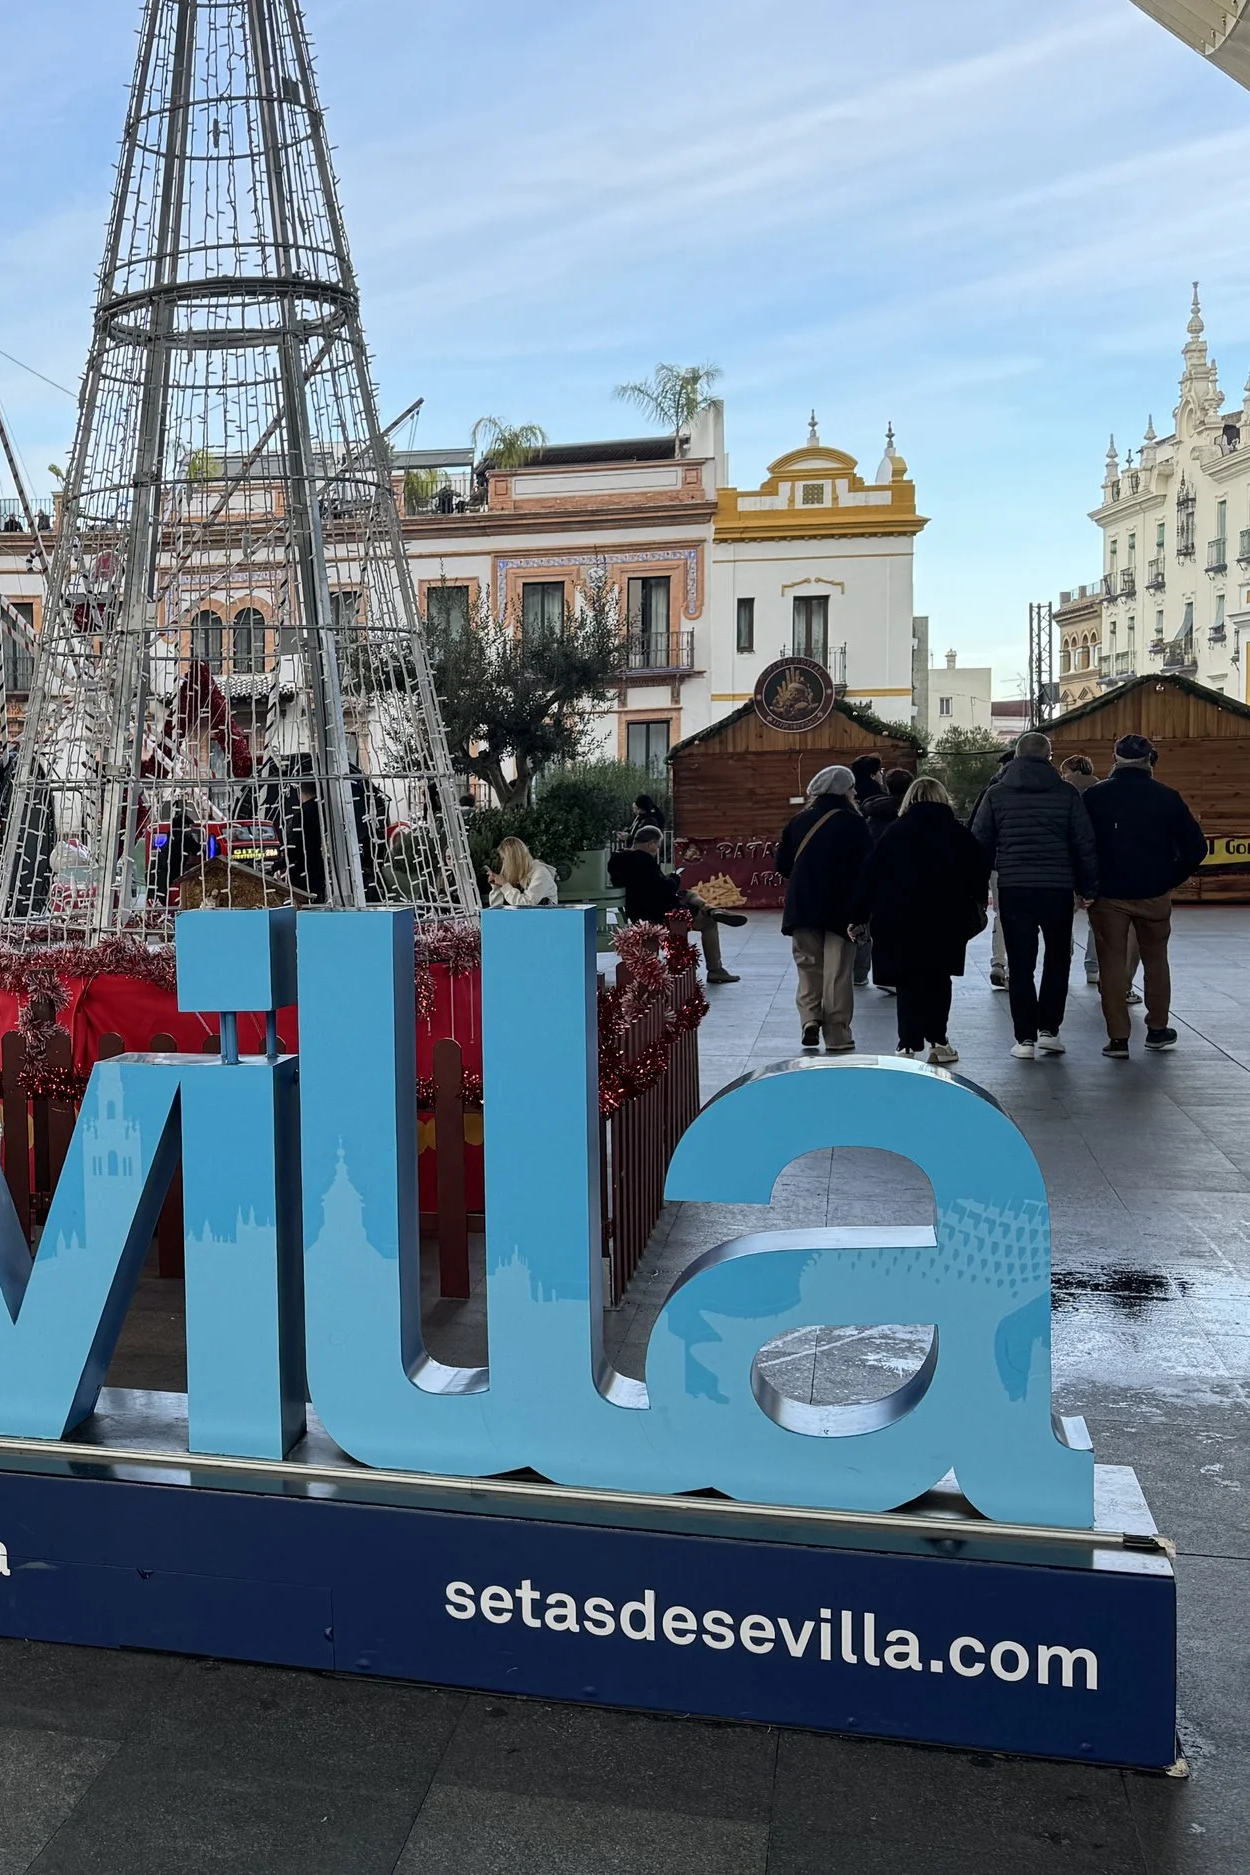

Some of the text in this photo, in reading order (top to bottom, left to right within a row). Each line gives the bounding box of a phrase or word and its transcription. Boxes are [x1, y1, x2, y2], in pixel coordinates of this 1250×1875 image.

[716, 841, 781, 860] PATA
[1225, 838, 1250, 855] Go
[444, 1579, 1099, 1691] setasdesevilla.com
